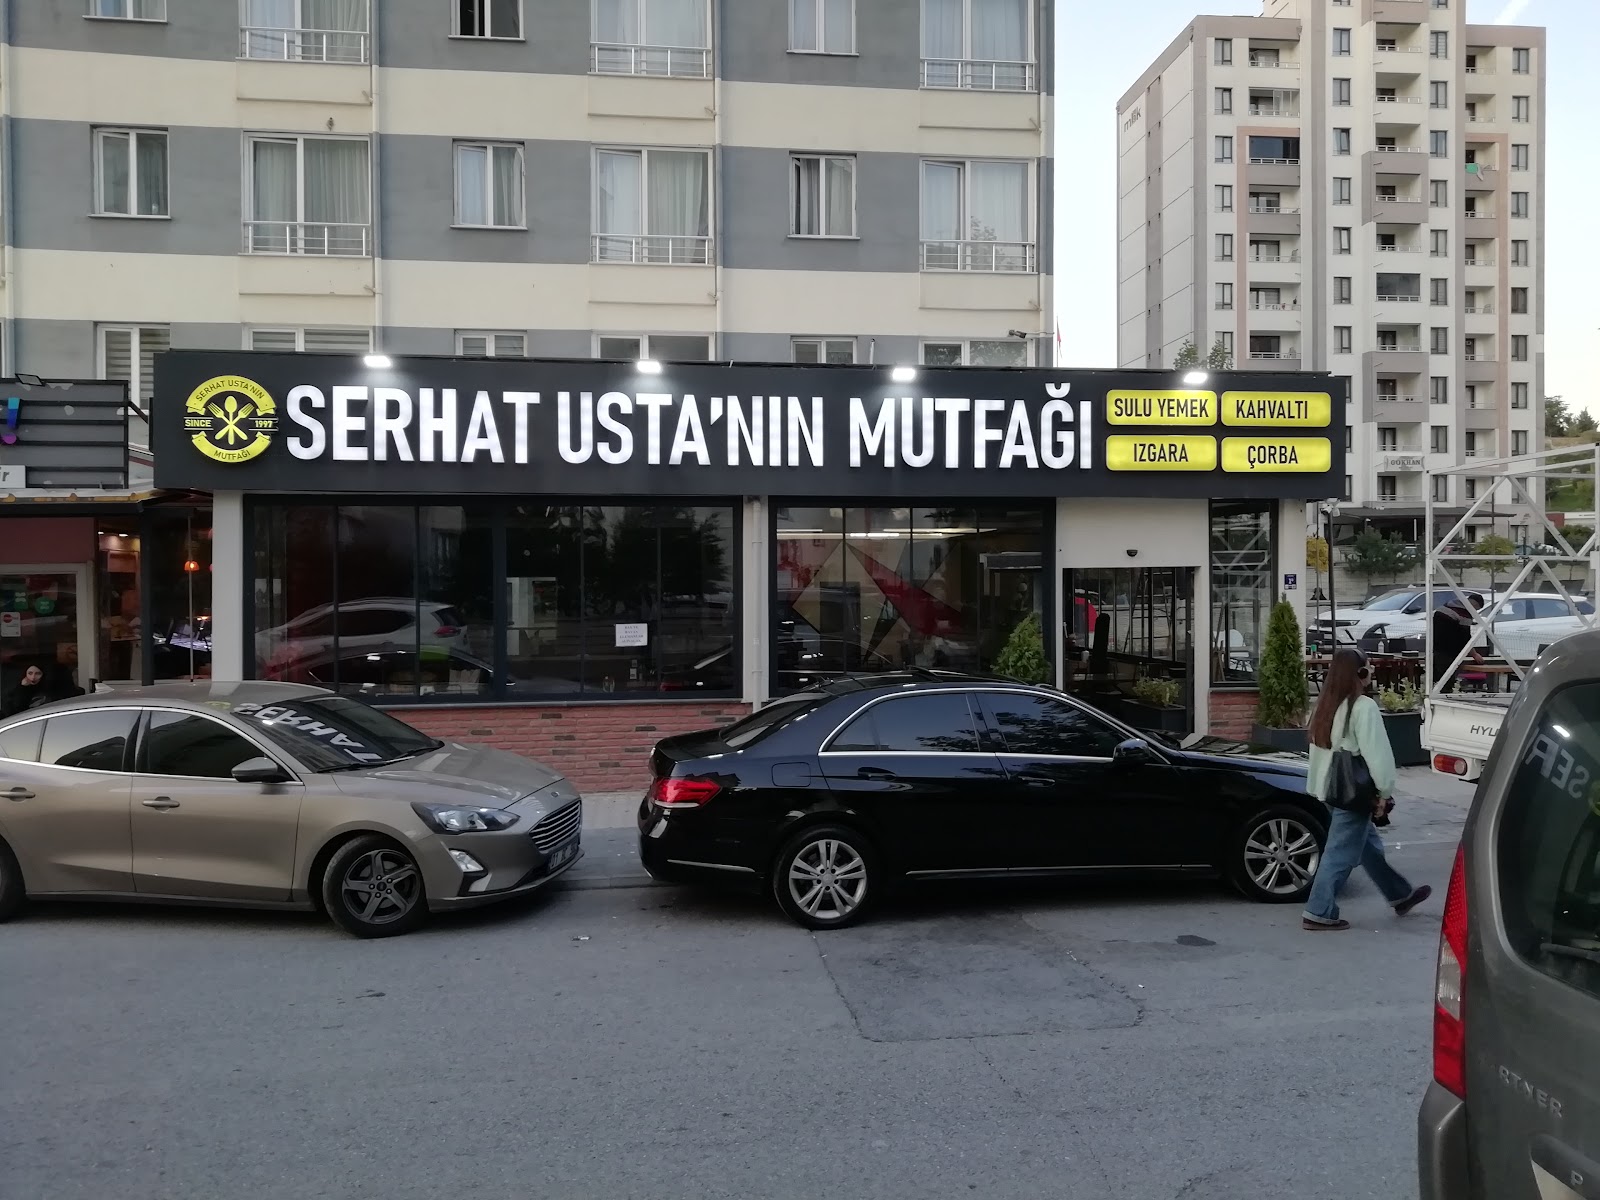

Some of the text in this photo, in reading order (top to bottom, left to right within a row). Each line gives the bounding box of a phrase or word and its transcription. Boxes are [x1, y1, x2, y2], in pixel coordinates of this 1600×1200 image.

[196, 380, 265, 402] SERHAT USTA'NIN
[1114, 397, 1209, 418] SULU YEMEK
[1236, 399, 1308, 419] KAHVALTI
[255, 420, 273, 428] 1997
[286, 382, 1092, 469] SERHAT USTA'NIN MUTFAĞI
[213, 449, 251, 460] MUTFAĞI
[1133, 443, 1189, 463] IZGARA
[1247, 445, 1299, 469] ÇORBA
